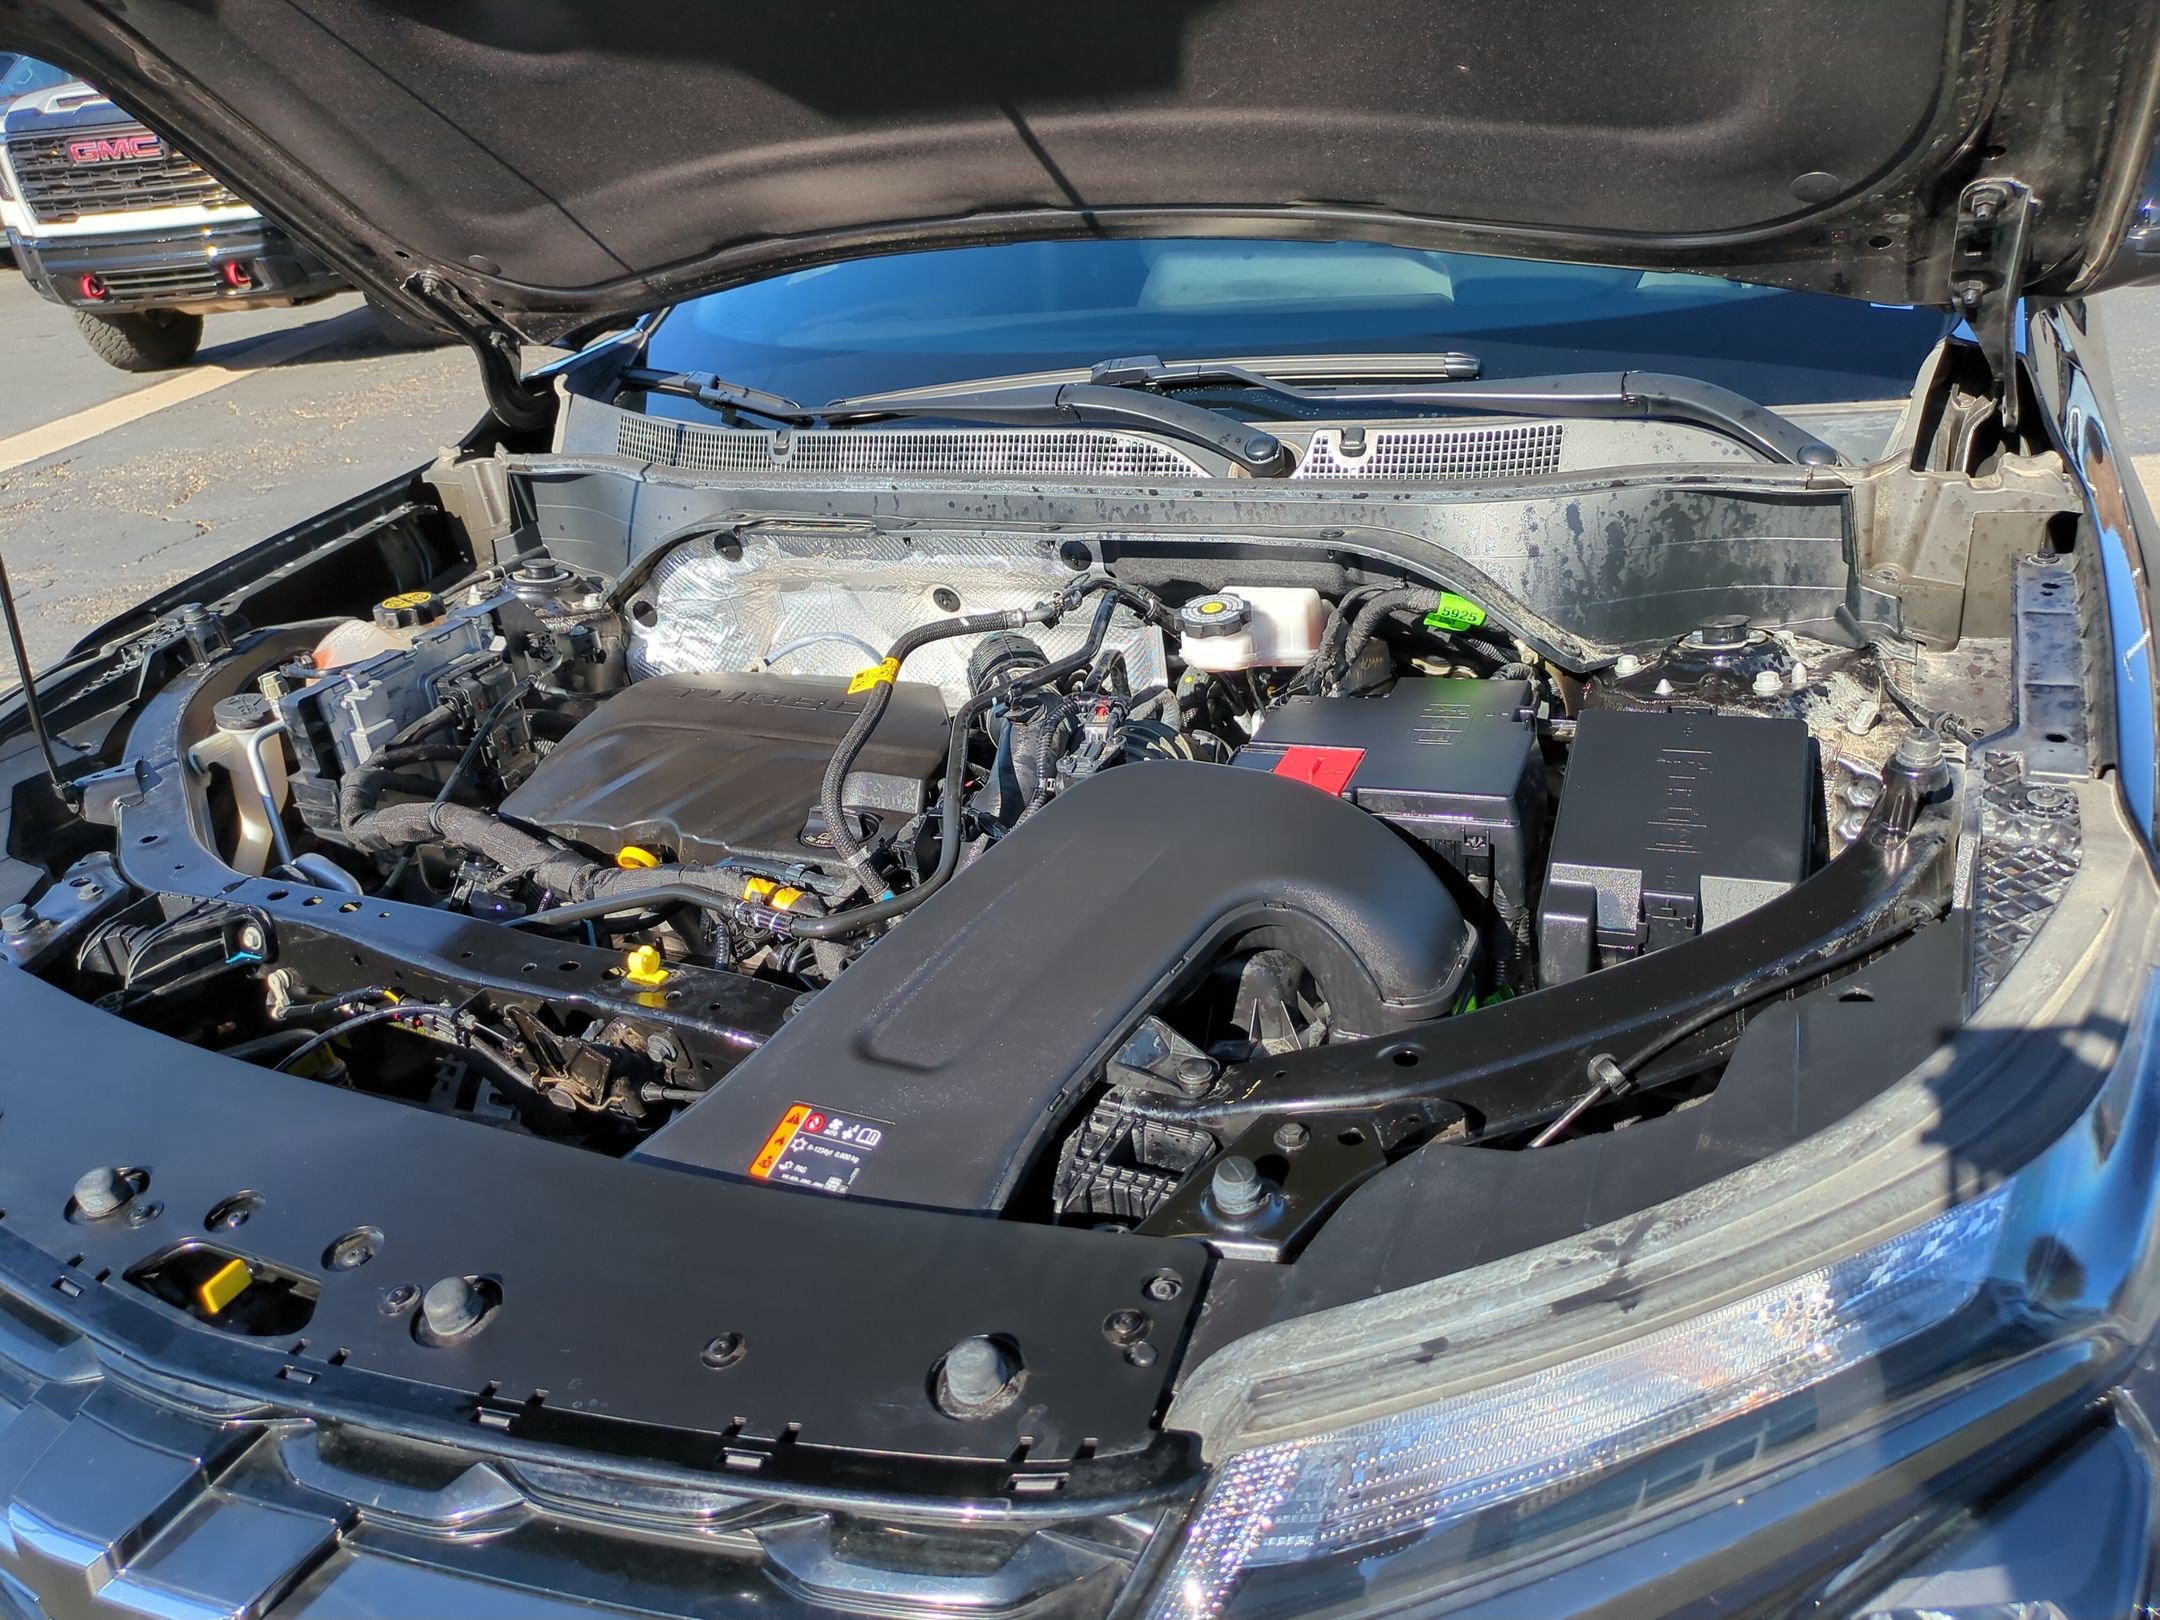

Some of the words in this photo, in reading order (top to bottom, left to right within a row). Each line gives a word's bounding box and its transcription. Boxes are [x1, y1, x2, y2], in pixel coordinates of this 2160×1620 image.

[71, 135, 161, 162] GMC
[1441, 607, 1477, 622] 5925
[669, 687, 864, 715] TURBO
